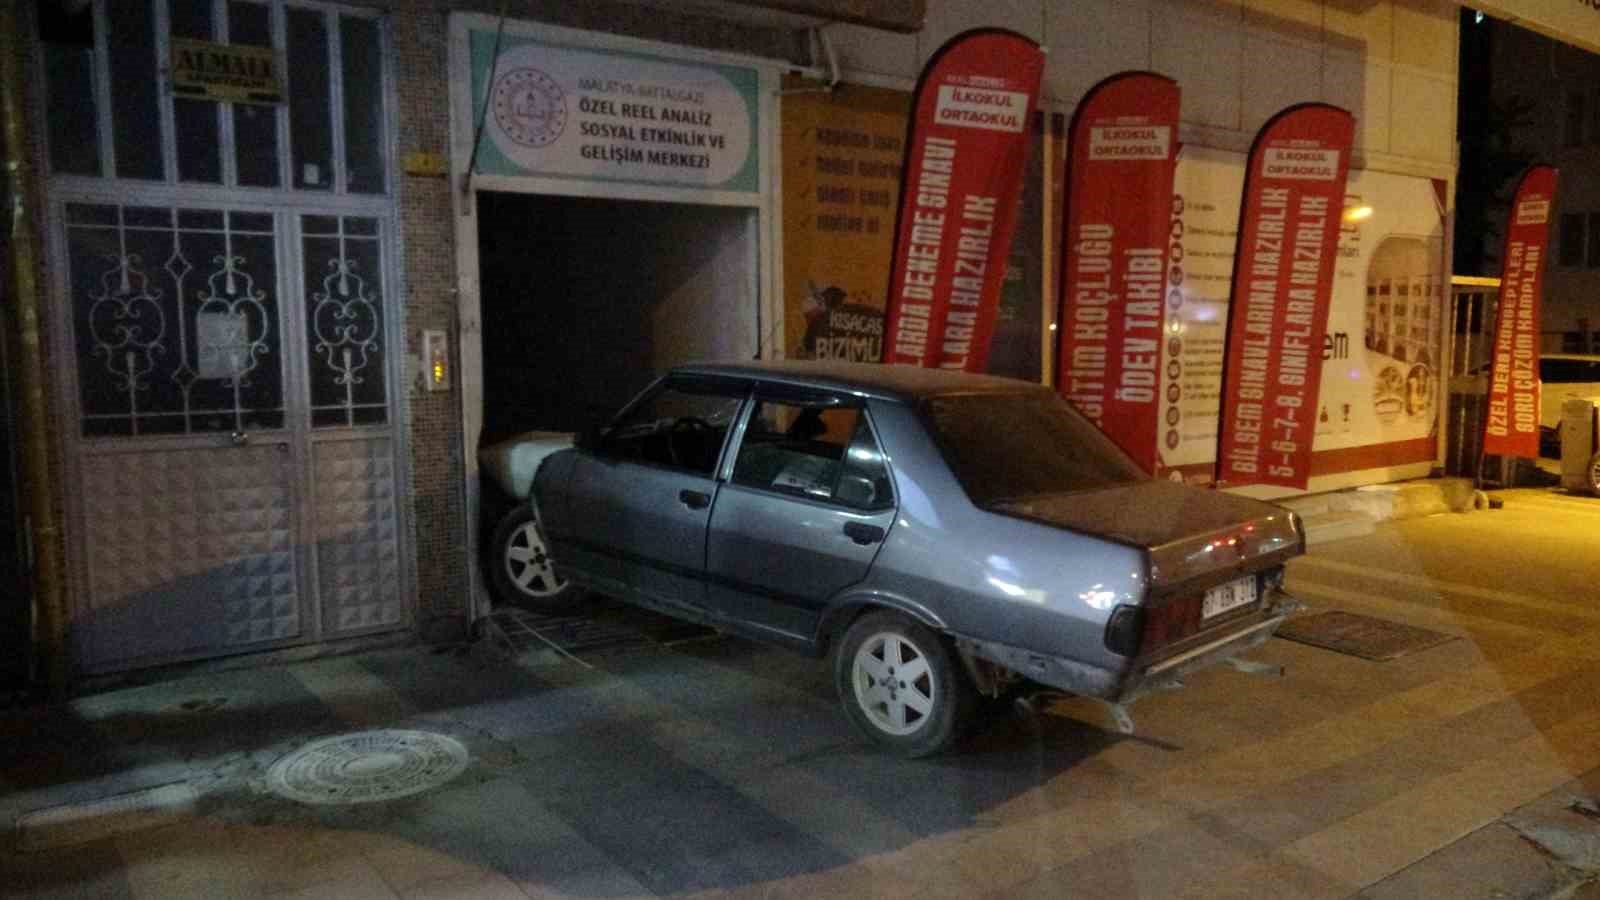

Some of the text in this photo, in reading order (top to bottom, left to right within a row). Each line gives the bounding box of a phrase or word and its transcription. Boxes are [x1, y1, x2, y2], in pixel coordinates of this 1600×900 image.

[579, 96, 712, 127] ÖZEL REEL ANALİZ
[940, 107, 1018, 127] ORTAOKUL
[951, 87, 1013, 107] İLKOKUL
[579, 121, 725, 149] SOSYAL ETKİNLİK VE
[581, 143, 711, 169] GELİŞİM MERKEZİ
[916, 137, 956, 209] SINAVI
[903, 211, 945, 300] DENEME
[951, 194, 997, 305] HAZIRLIK
[1296, 195, 1329, 284] HAZIRLIK
[1073, 223, 1117, 341] KOÇLUĞU
[1114, 247, 1164, 402] ÖDEV TAKİBİ
[1231, 187, 1289, 473] BİLSEM SINAVLARINA HAZIRLIK
[1278, 287, 1315, 384] SINIFLARA
[1512, 336, 1537, 391] ÇÖZÜM
[1487, 397, 1510, 437] ÖZEL
[1512, 394, 1536, 434] SORU
